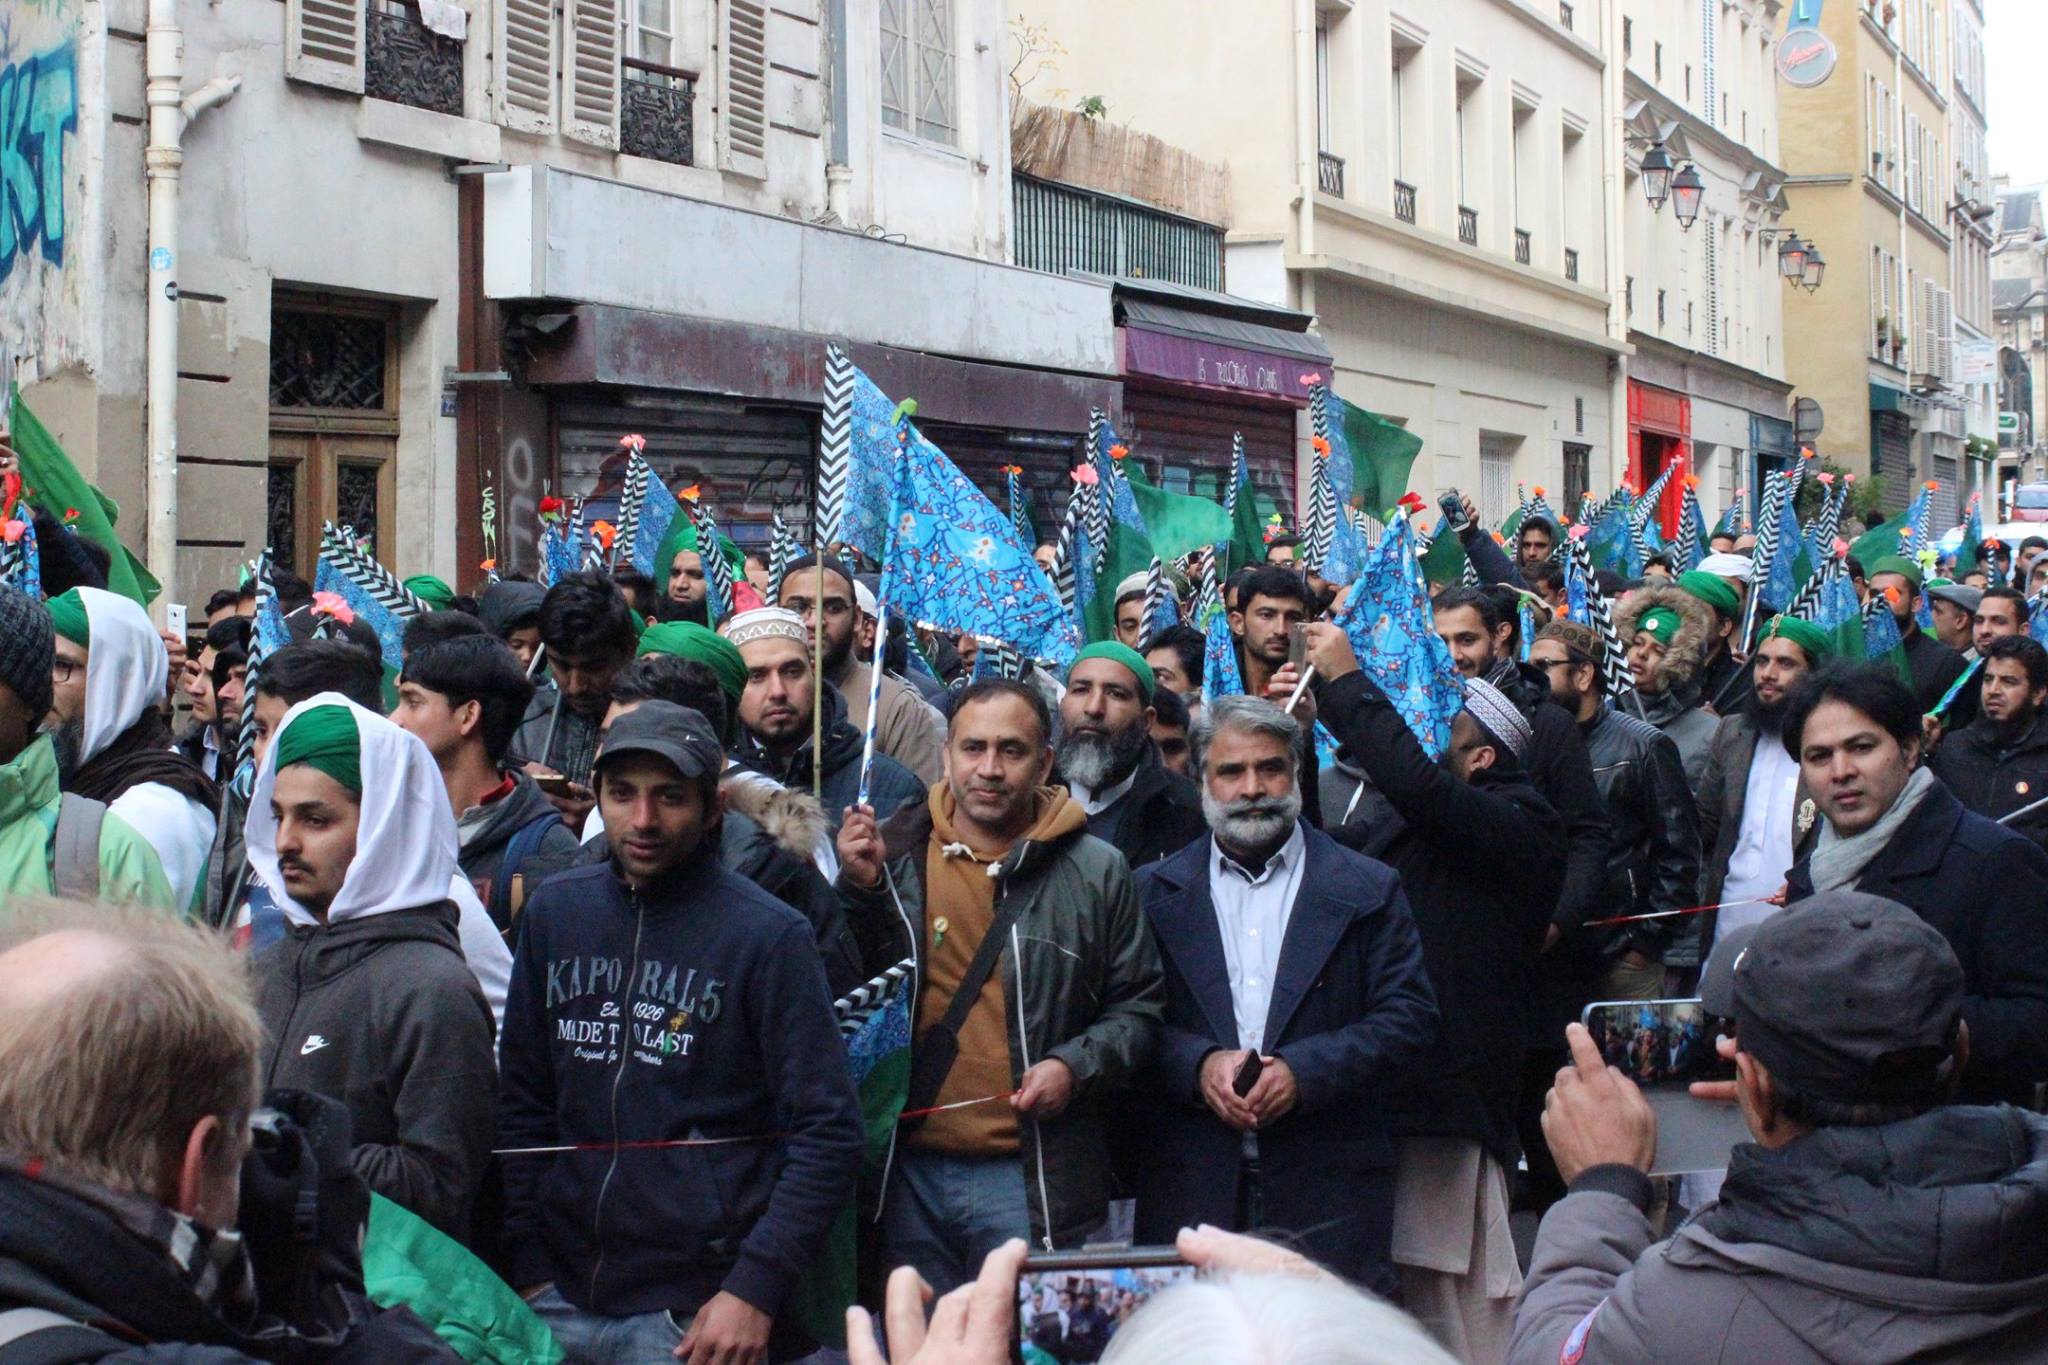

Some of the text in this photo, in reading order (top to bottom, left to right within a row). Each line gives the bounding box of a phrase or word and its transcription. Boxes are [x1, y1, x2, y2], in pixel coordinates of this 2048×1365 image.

[633, 1001, 665, 1021] 1926
[557, 1019, 604, 1043] MADE
[642, 1025, 693, 1055] LAST
